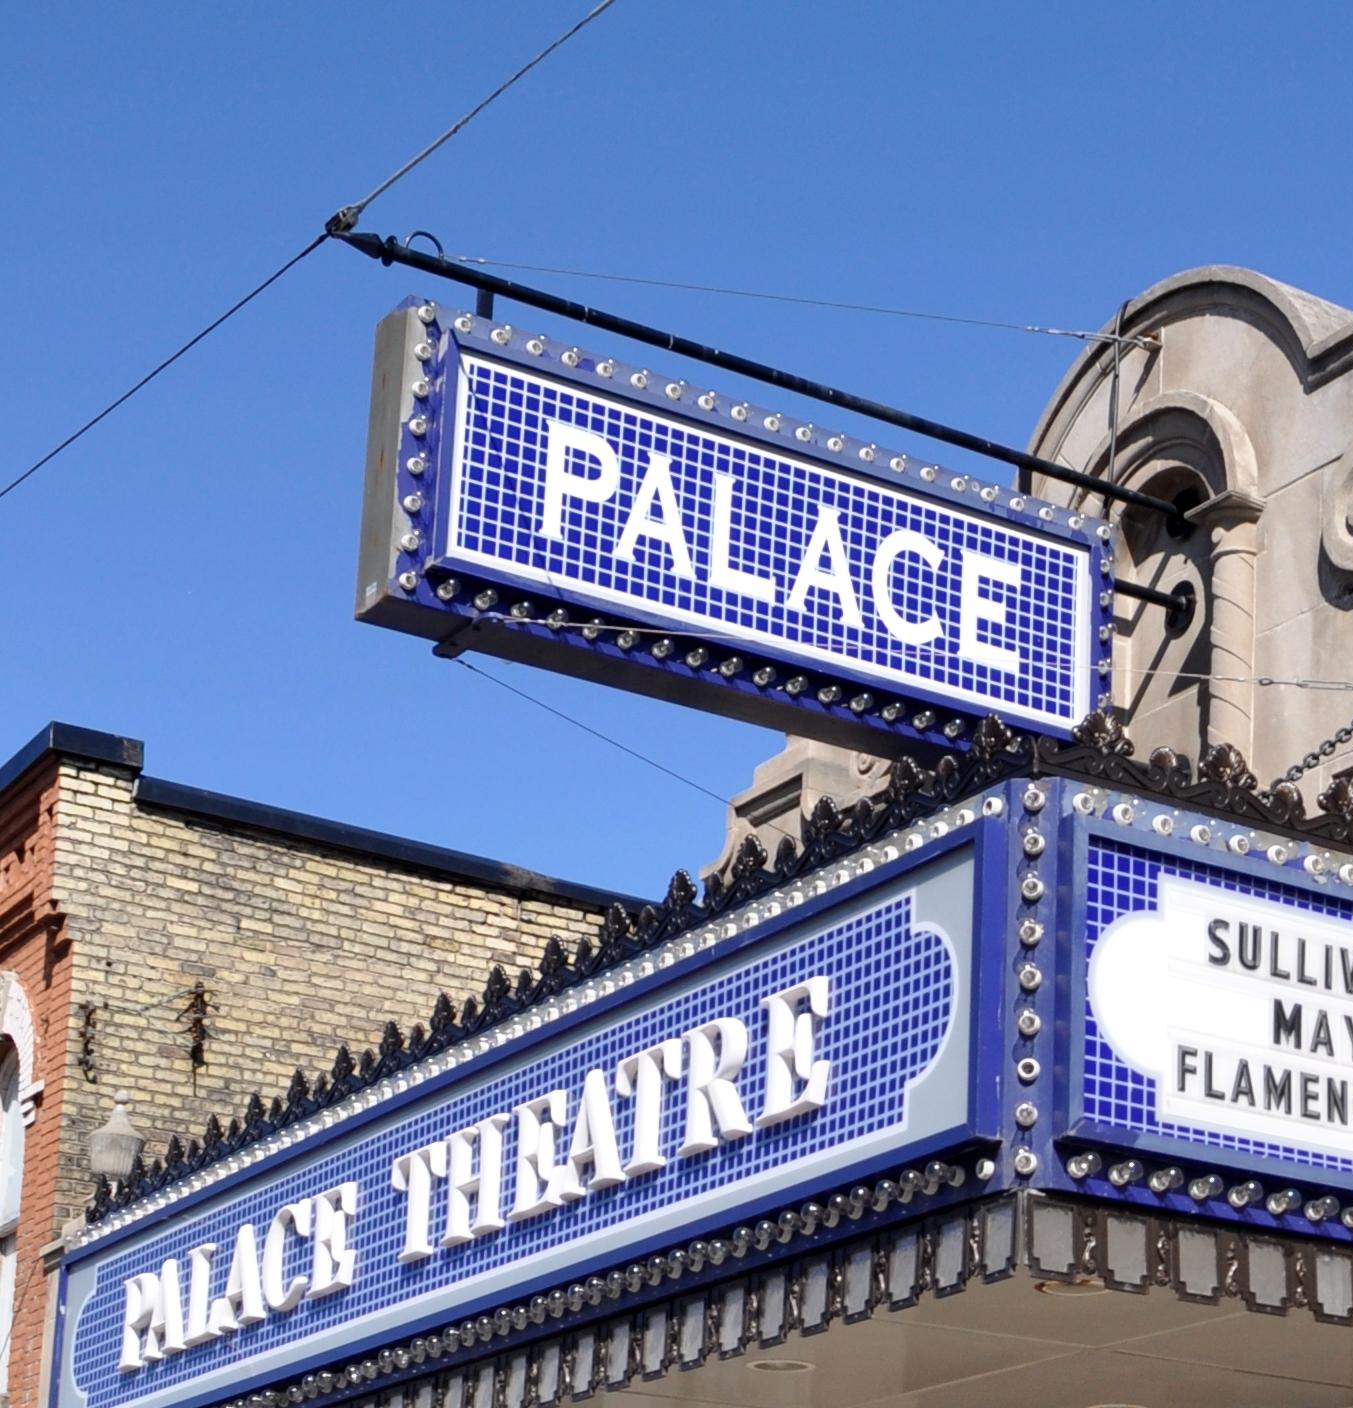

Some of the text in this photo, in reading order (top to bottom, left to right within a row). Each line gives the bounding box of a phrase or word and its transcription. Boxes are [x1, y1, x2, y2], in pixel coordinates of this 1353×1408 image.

[537, 418, 1022, 675] PALACE
[118, 976, 830, 1373] PALACE THEATRE
